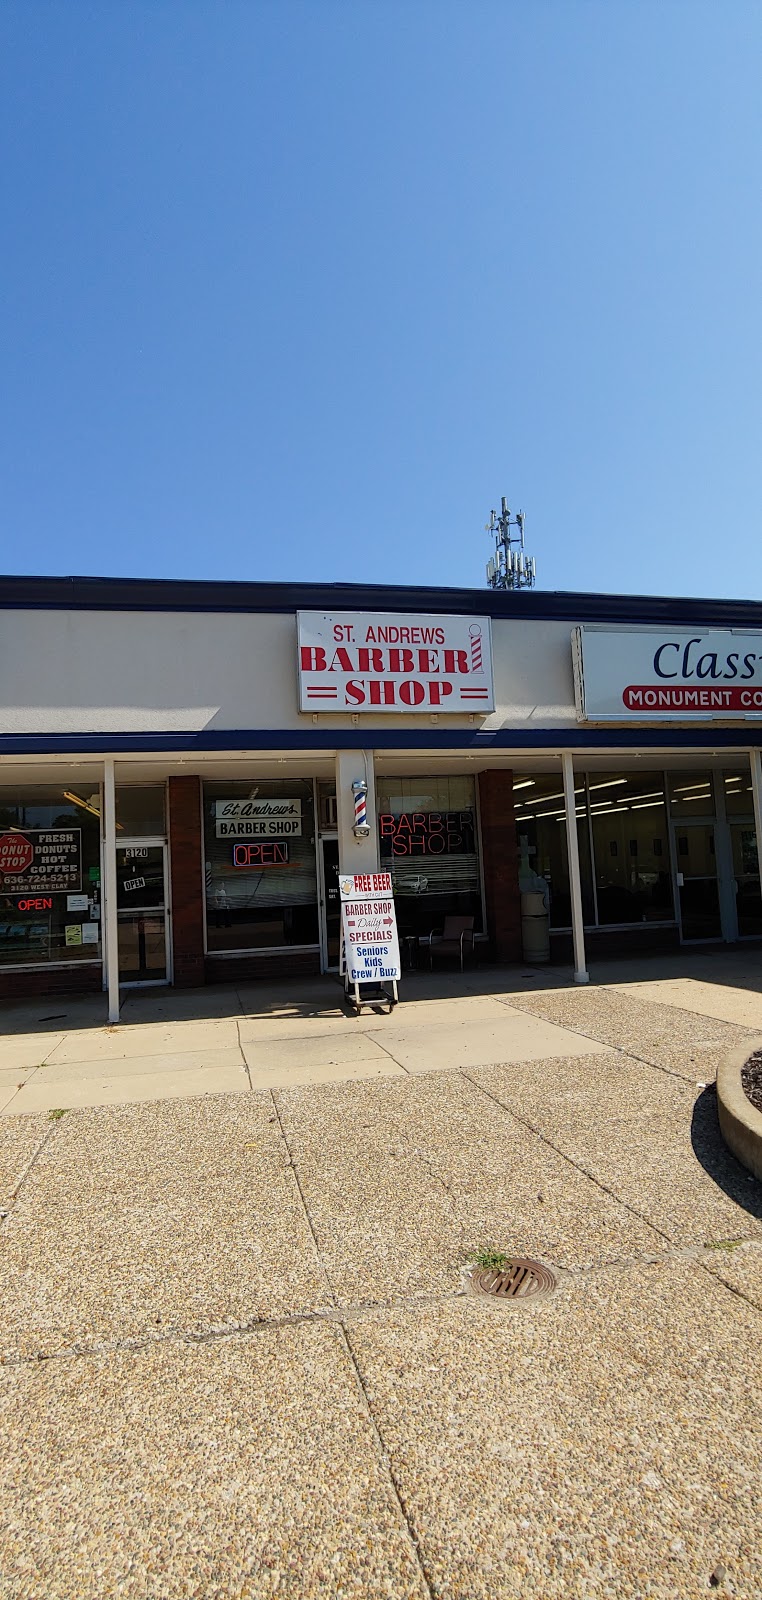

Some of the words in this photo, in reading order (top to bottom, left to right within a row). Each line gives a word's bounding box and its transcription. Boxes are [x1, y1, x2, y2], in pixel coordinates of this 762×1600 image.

[333, 624, 356, 643] ST.
[365, 625, 445, 645] ANDREWS
[300, 646, 471, 674] BARBER
[653, 638, 762, 679] Class
[344, 679, 453, 706] SHOP
[628, 690, 733, 706] MONUMENT
[222, 803, 241, 816] St.
[241, 803, 298, 816] Andrews
[220, 822, 267, 835] BARBER
[268, 821, 299, 834] SHOP
[380, 812, 474, 835] BARBER
[38, 834, 74, 843] FRESH
[393, 833, 462, 855] SHOP
[0, 845, 30, 855] ONUT
[35, 845, 77, 855] DONUTS
[126, 848, 147, 857] 3120
[235, 844, 287, 865] OPEN
[0, 857, 26, 868] STOP
[30, 864, 78, 873] COFFEE
[3, 874, 77, 884] 636-724-5213
[125, 877, 144, 890] OPEN
[353, 874, 372, 892] FREE
[372, 873, 391, 891] BEER
[17, 897, 53, 911] OPEN
[345, 903, 373, 916] BARBER
[373, 902, 392, 915] SHOP
[357, 917, 382, 931] Daily
[349, 930, 393, 942] SPECIALS
[356, 946, 388, 956] Seniors
[364, 957, 383, 967] Kids
[351, 968, 373, 979] Crew
[380, 967, 397, 977] Buzz
